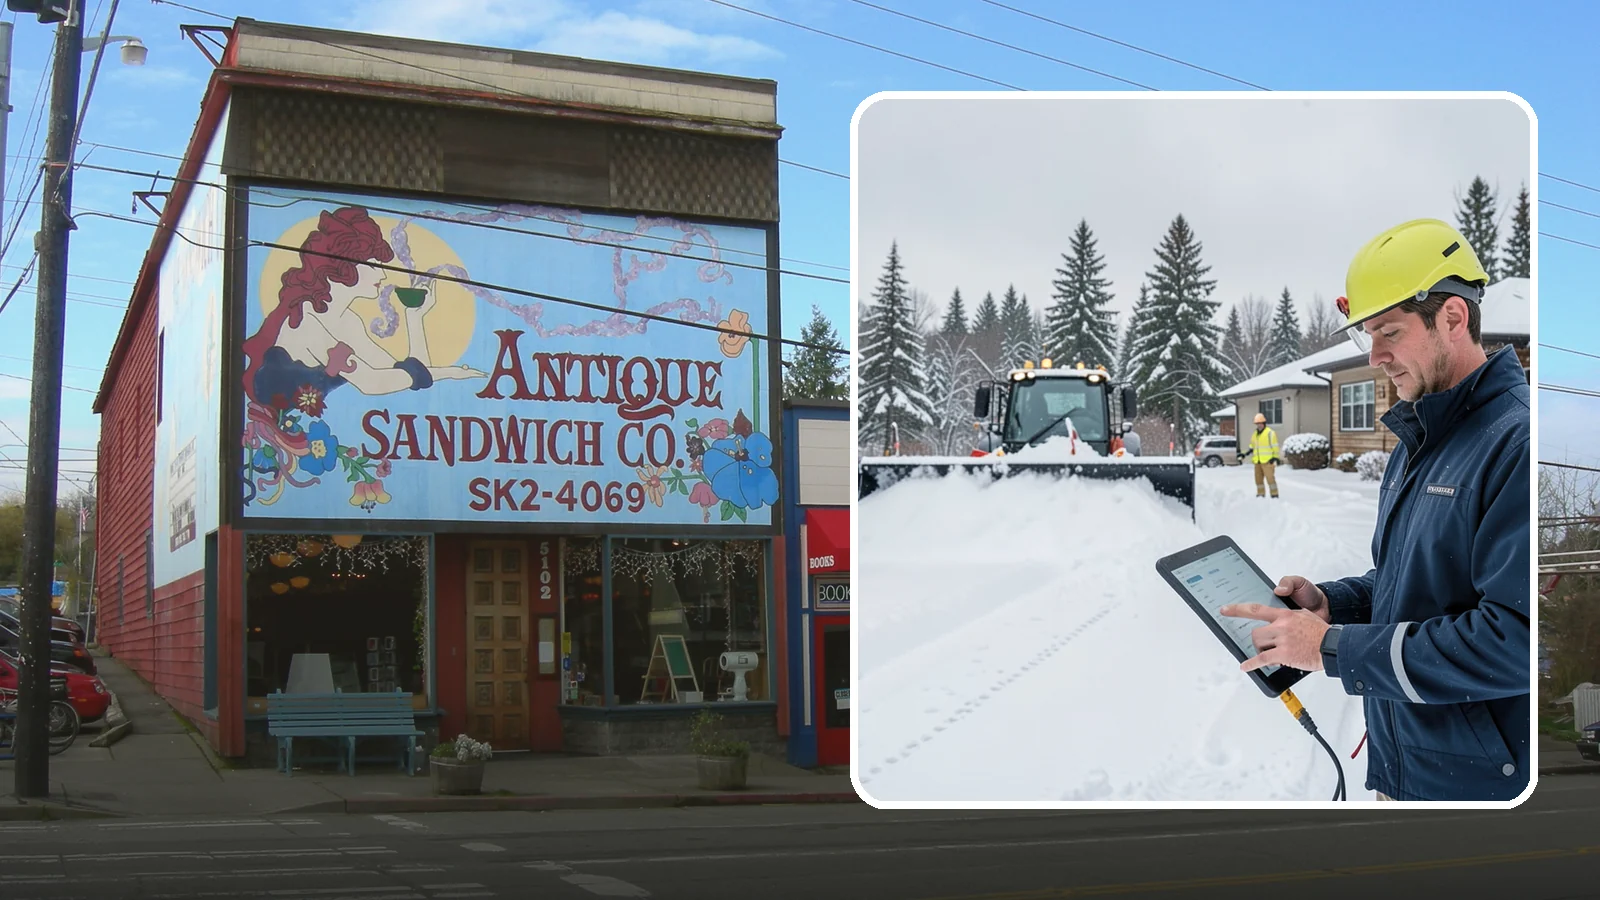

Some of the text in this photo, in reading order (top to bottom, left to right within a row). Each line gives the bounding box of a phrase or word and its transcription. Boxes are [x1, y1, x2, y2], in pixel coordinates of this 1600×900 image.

[361, 408, 685, 468] SANDWICH CO.
[469, 478, 645, 512] SK2-4069
[540, 541, 551, 600] 5102
[809, 554, 835, 569] BOOKS
